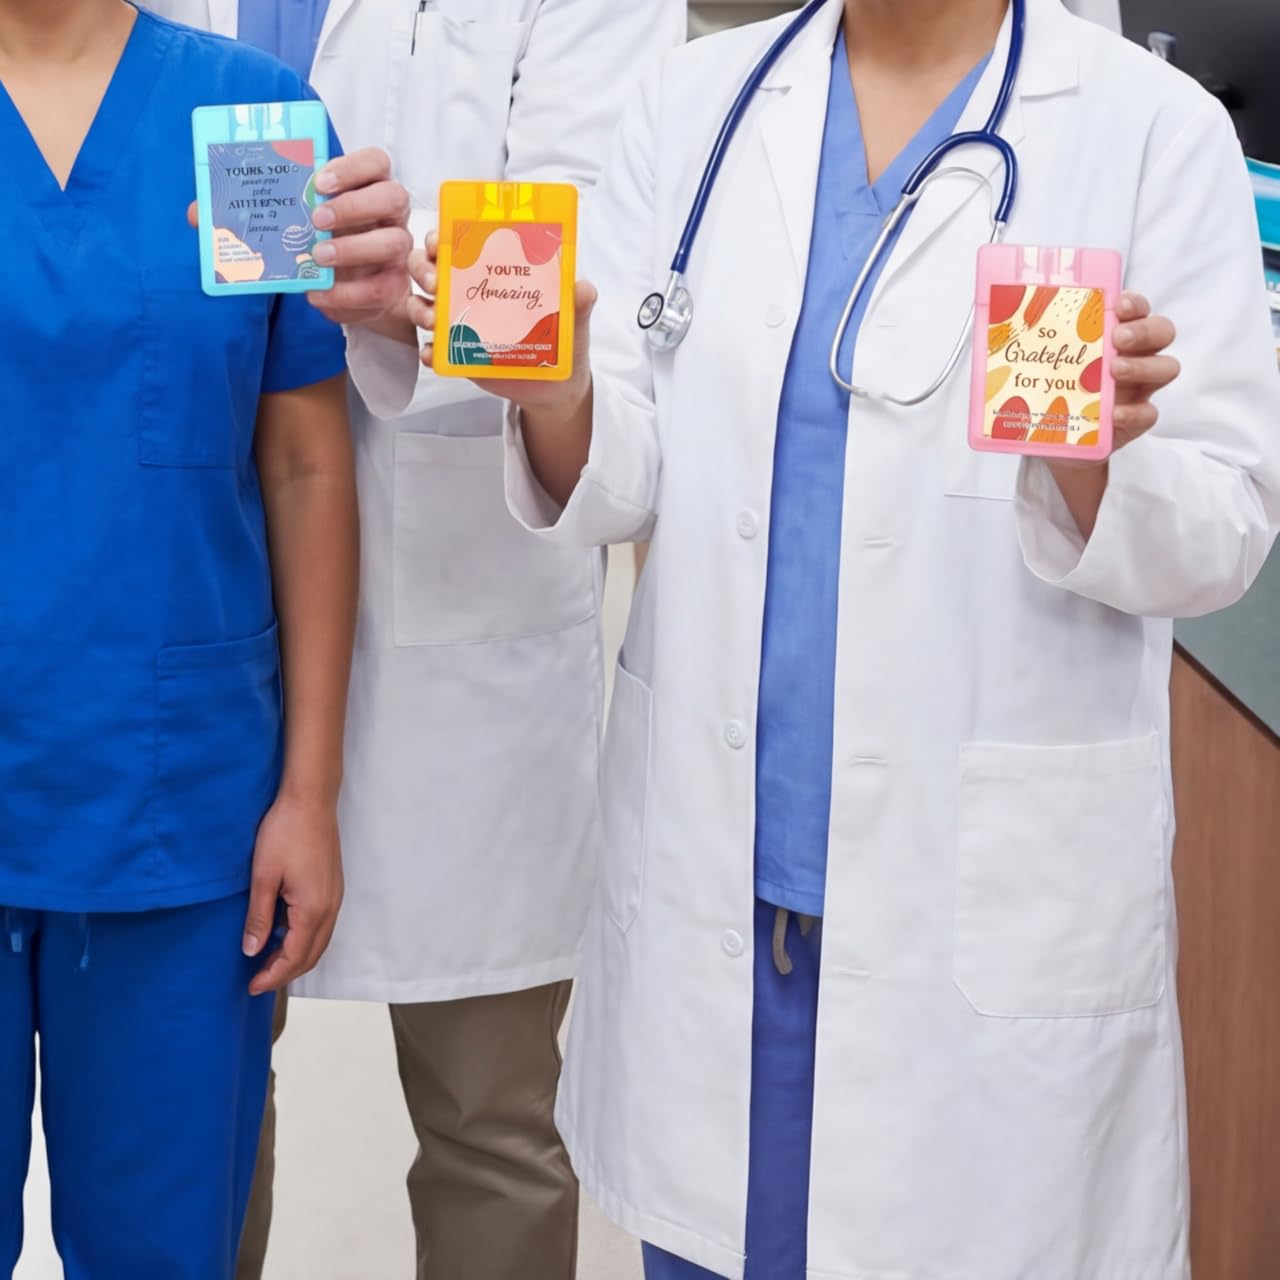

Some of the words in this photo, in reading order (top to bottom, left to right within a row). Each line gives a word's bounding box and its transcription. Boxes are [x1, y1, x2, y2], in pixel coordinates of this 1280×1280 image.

[1005, 339, 1088, 370] Grateful
[1015, 372, 1040, 388] for
[1043, 377, 1076, 394] you
